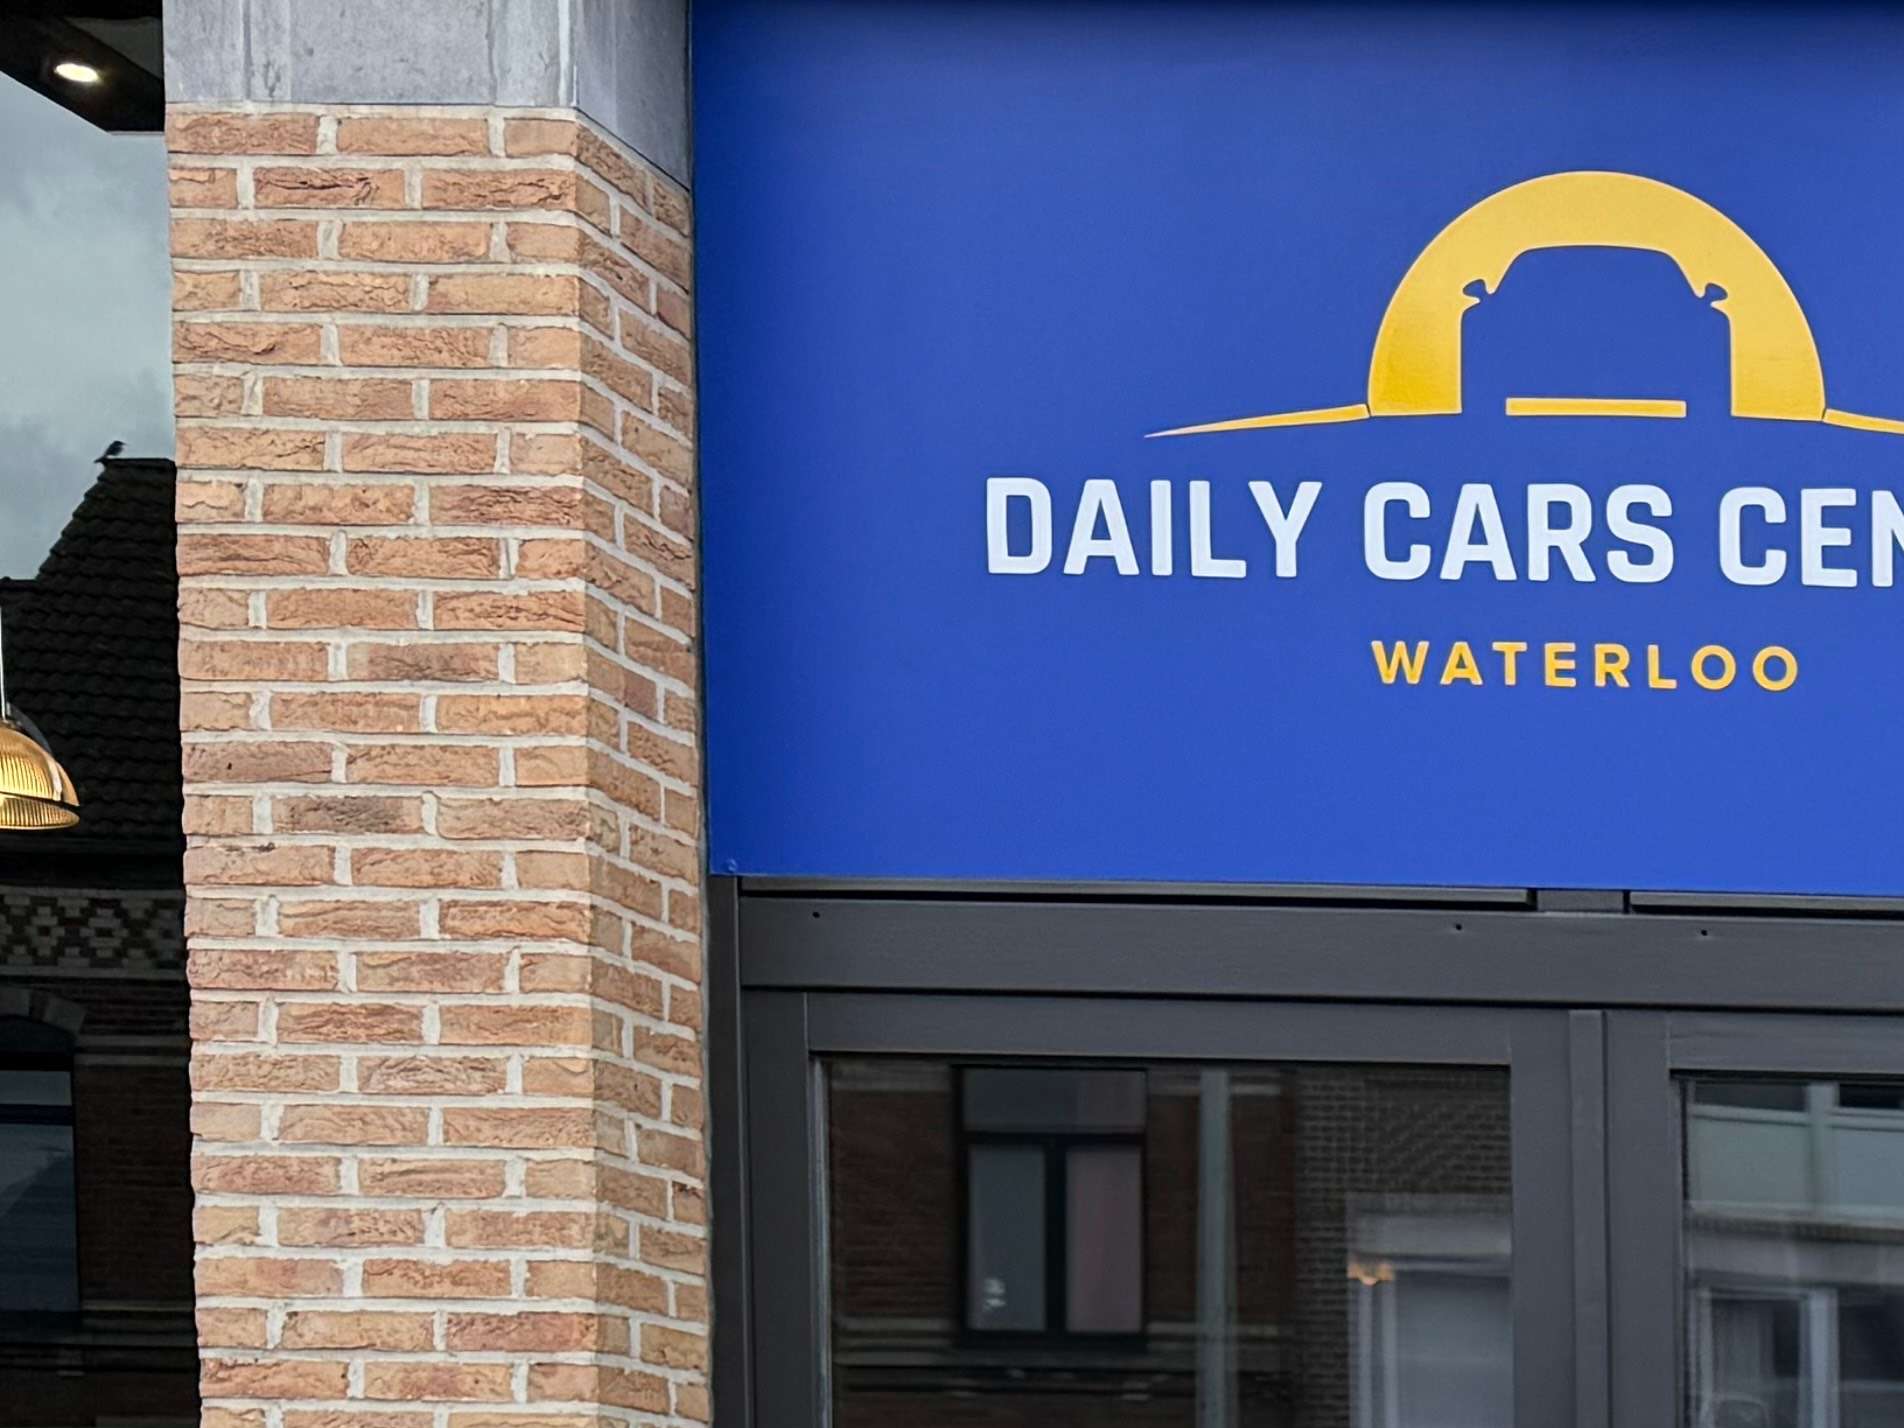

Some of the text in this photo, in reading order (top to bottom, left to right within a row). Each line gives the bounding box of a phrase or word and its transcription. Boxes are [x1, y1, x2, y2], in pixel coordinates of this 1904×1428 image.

[987, 478, 1322, 579] DAILY
[1364, 482, 1673, 582] CARS
[1371, 640, 1798, 692] WATERLOO
